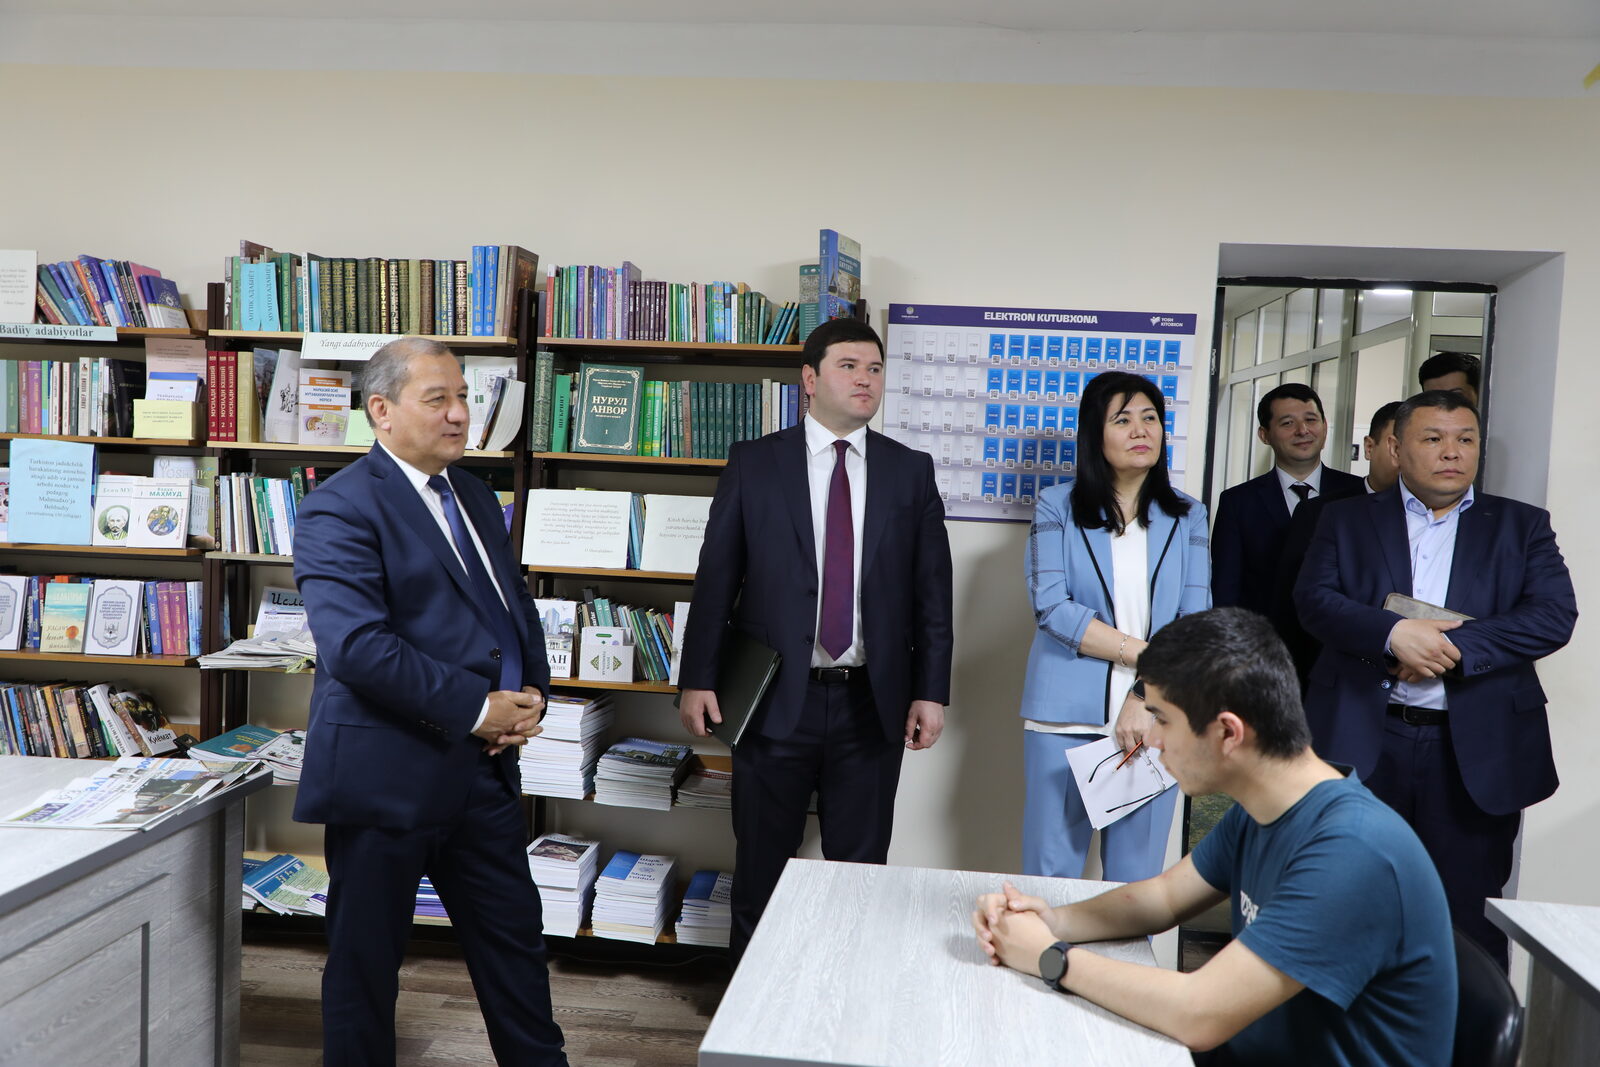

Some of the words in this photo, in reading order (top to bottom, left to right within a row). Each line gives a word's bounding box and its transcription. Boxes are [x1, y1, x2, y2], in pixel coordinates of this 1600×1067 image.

[984, 311, 1035, 322] ELEKTRON
[1036, 313, 1098, 324] KUTUBXONA
[0, 325, 31, 337] Badiiy
[35, 327, 94, 339] adabiyotlar
[320, 339, 342, 350] Yangi
[592, 395, 628, 406] НУРУЛ
[590, 405, 628, 415] АНВОР
